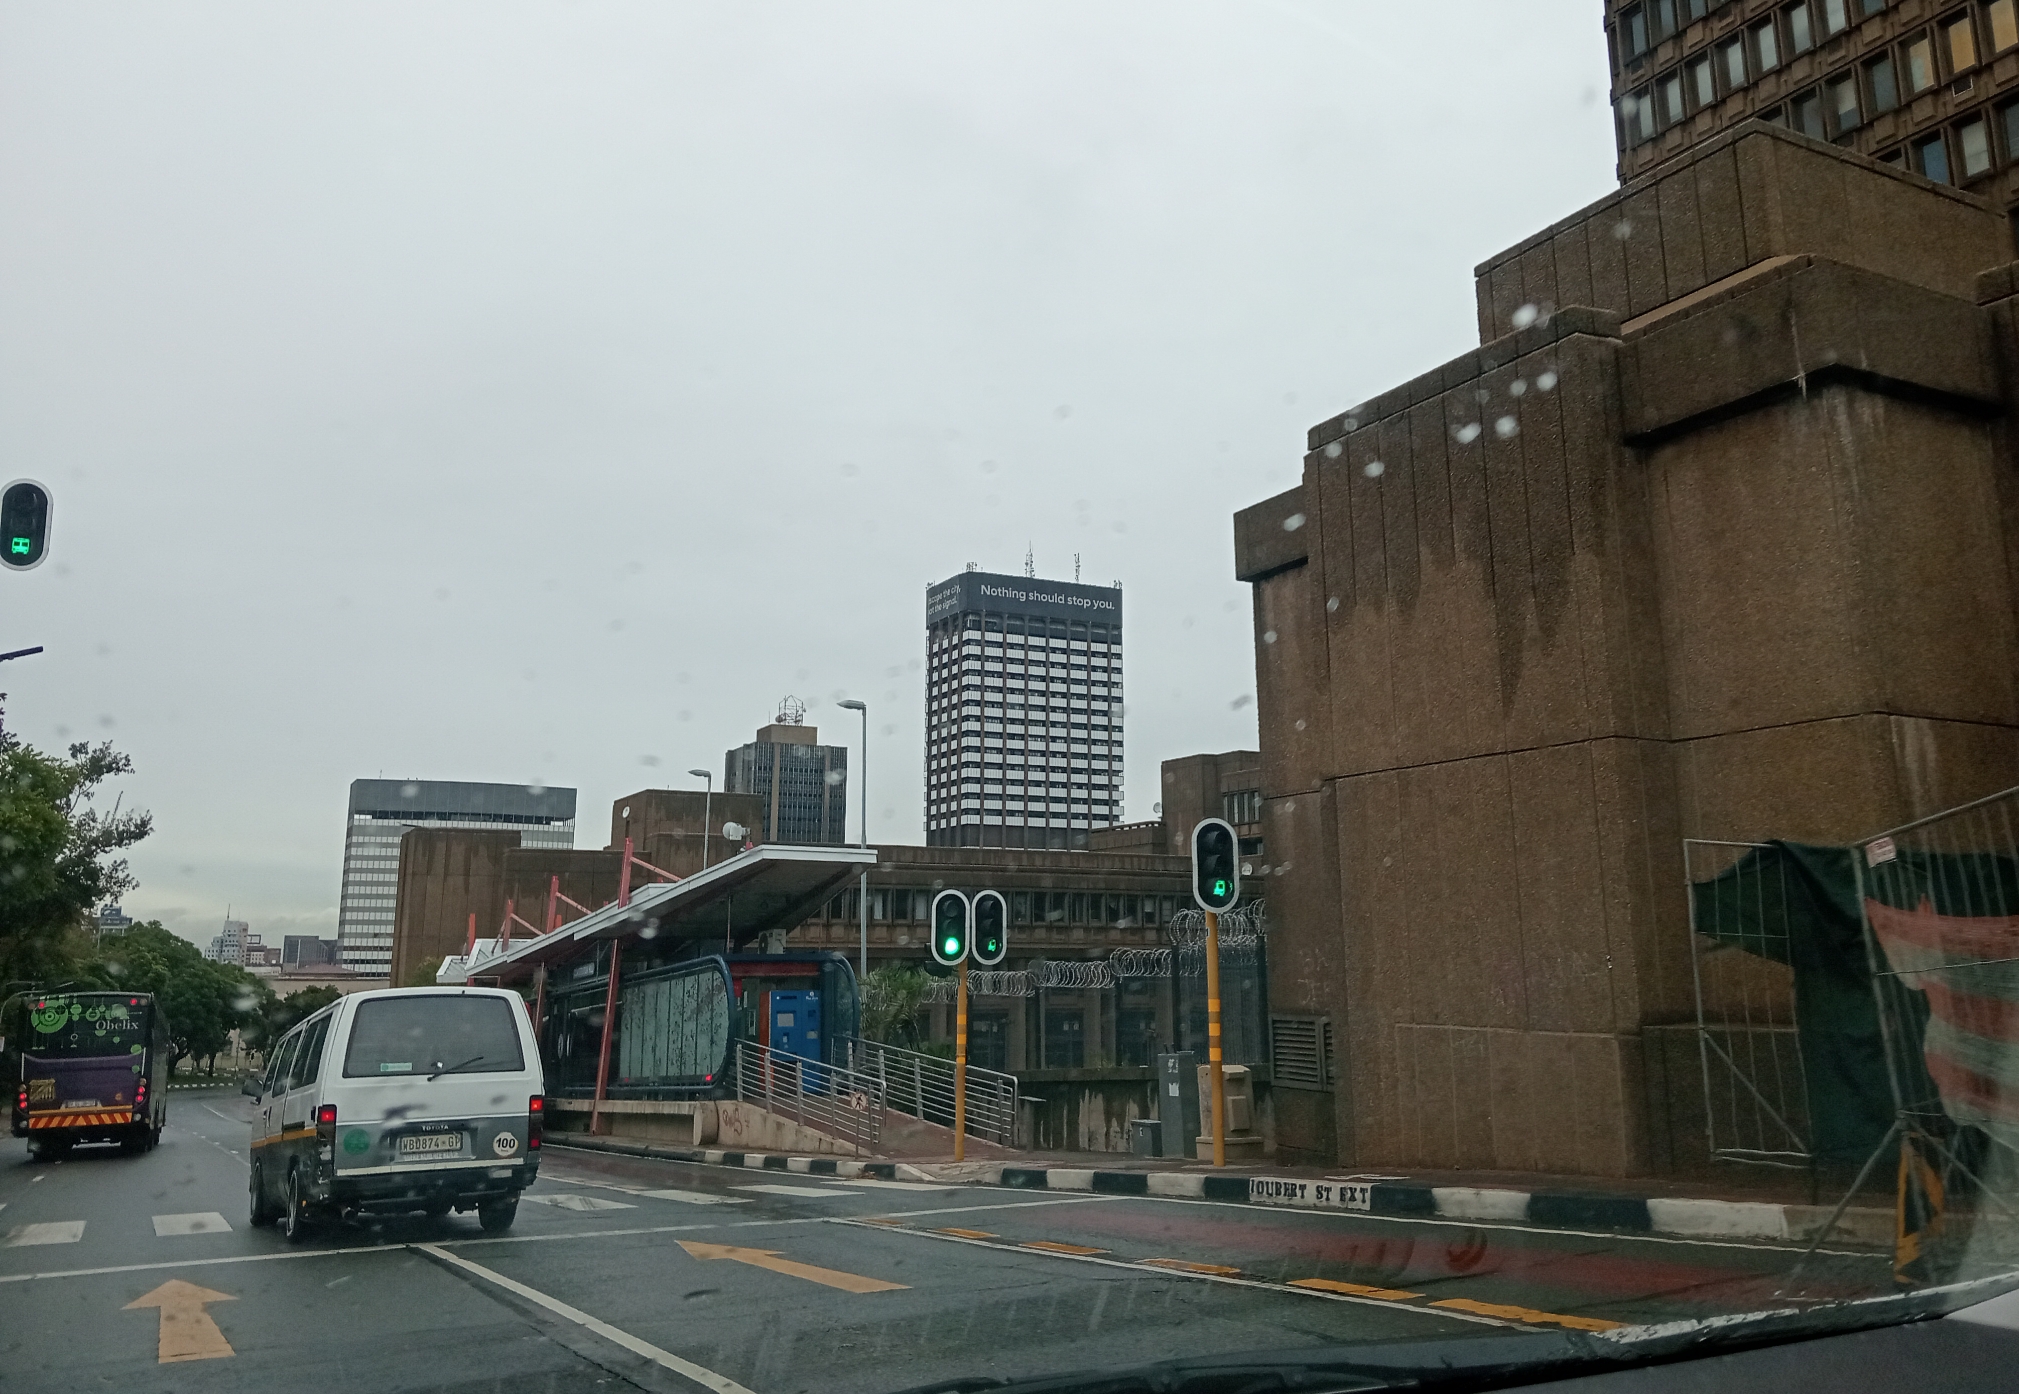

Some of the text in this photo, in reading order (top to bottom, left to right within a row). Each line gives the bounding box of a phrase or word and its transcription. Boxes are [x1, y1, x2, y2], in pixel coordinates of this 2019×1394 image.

[980, 584, 1115, 610] Nothing should stop you.
[96, 1017, 139, 1030] Obelix
[448, 1135, 461, 1148] GP
[495, 1137, 516, 1149] 100
[1316, 1184, 1333, 1202] ST
[1340, 1186, 1369, 1204] EXT
